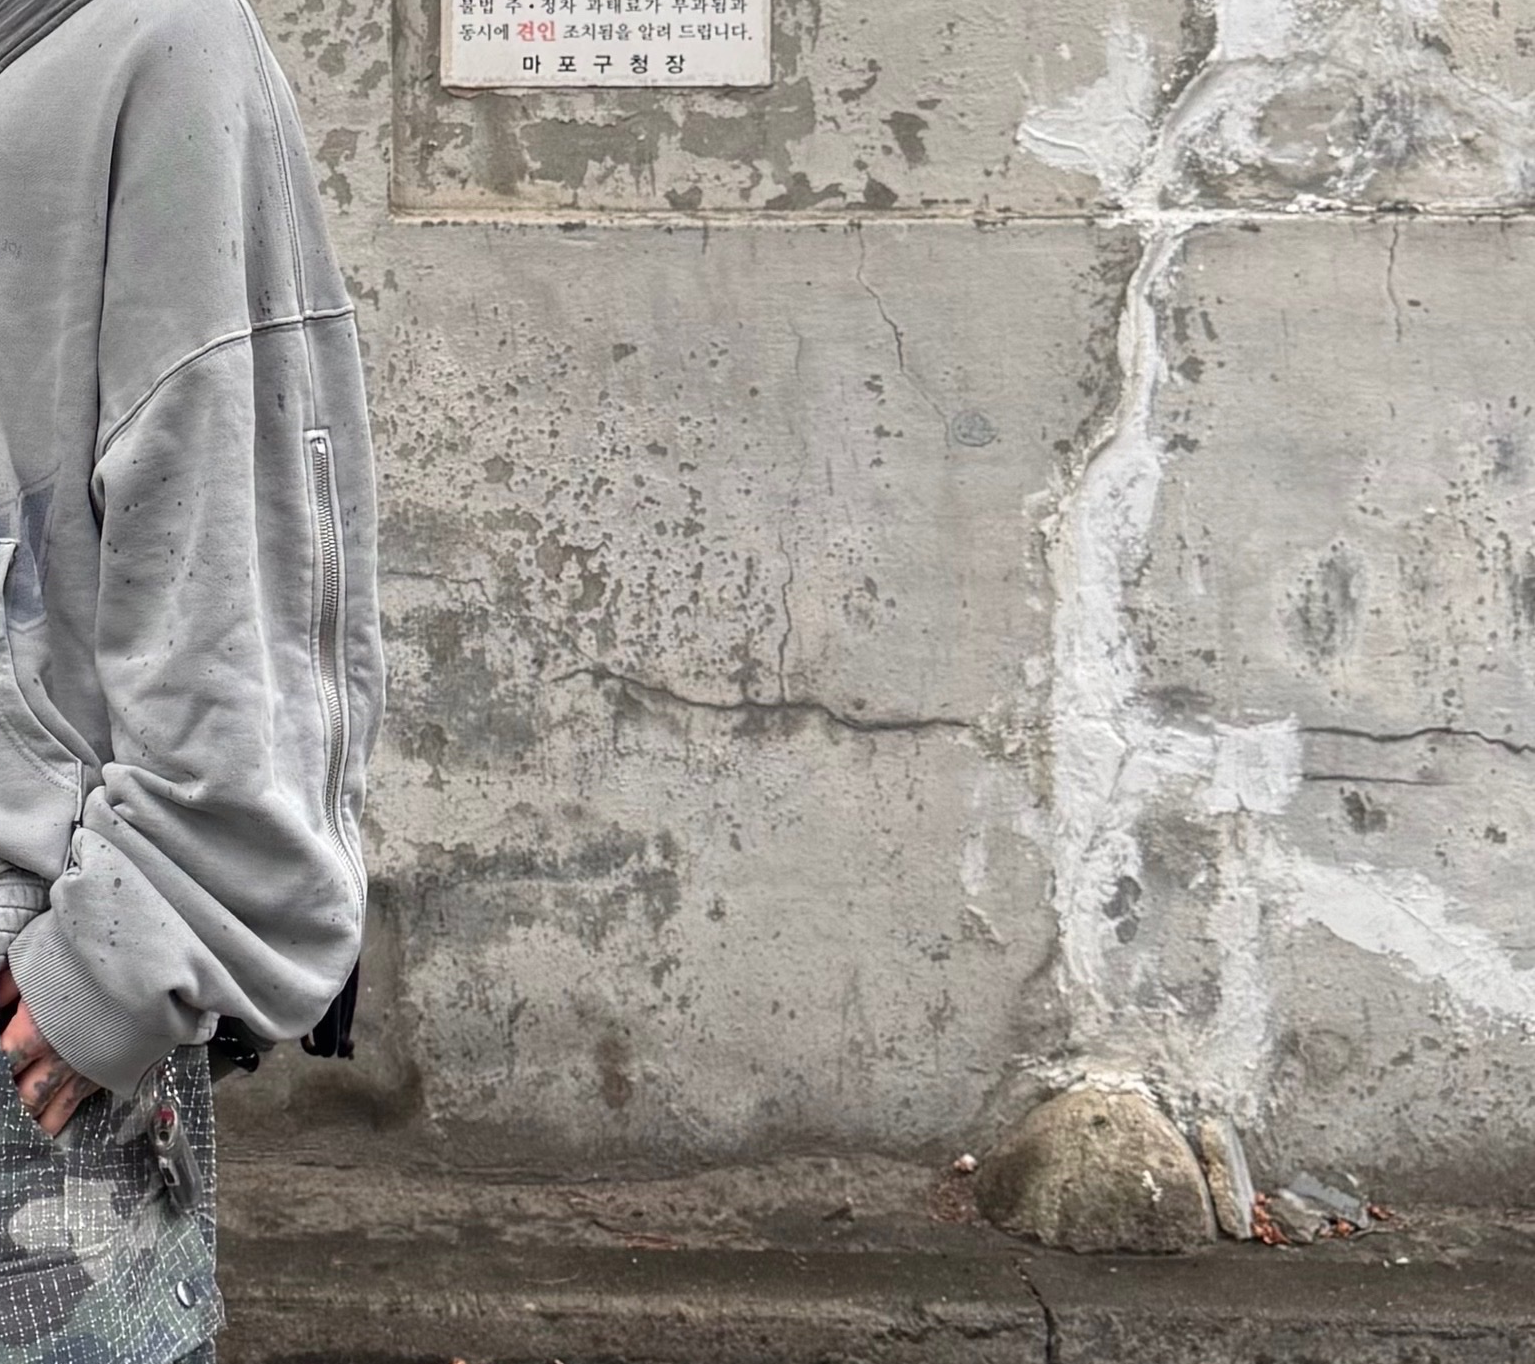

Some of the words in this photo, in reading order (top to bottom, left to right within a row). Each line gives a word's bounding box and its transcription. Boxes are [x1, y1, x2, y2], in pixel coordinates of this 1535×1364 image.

[458, 22, 510, 42] 동시에
[516, 20, 557, 42] 견인
[563, 22, 633, 42] 조치됨을
[637, 22, 671, 42] 알려
[677, 22, 754, 42] 드립니다.
